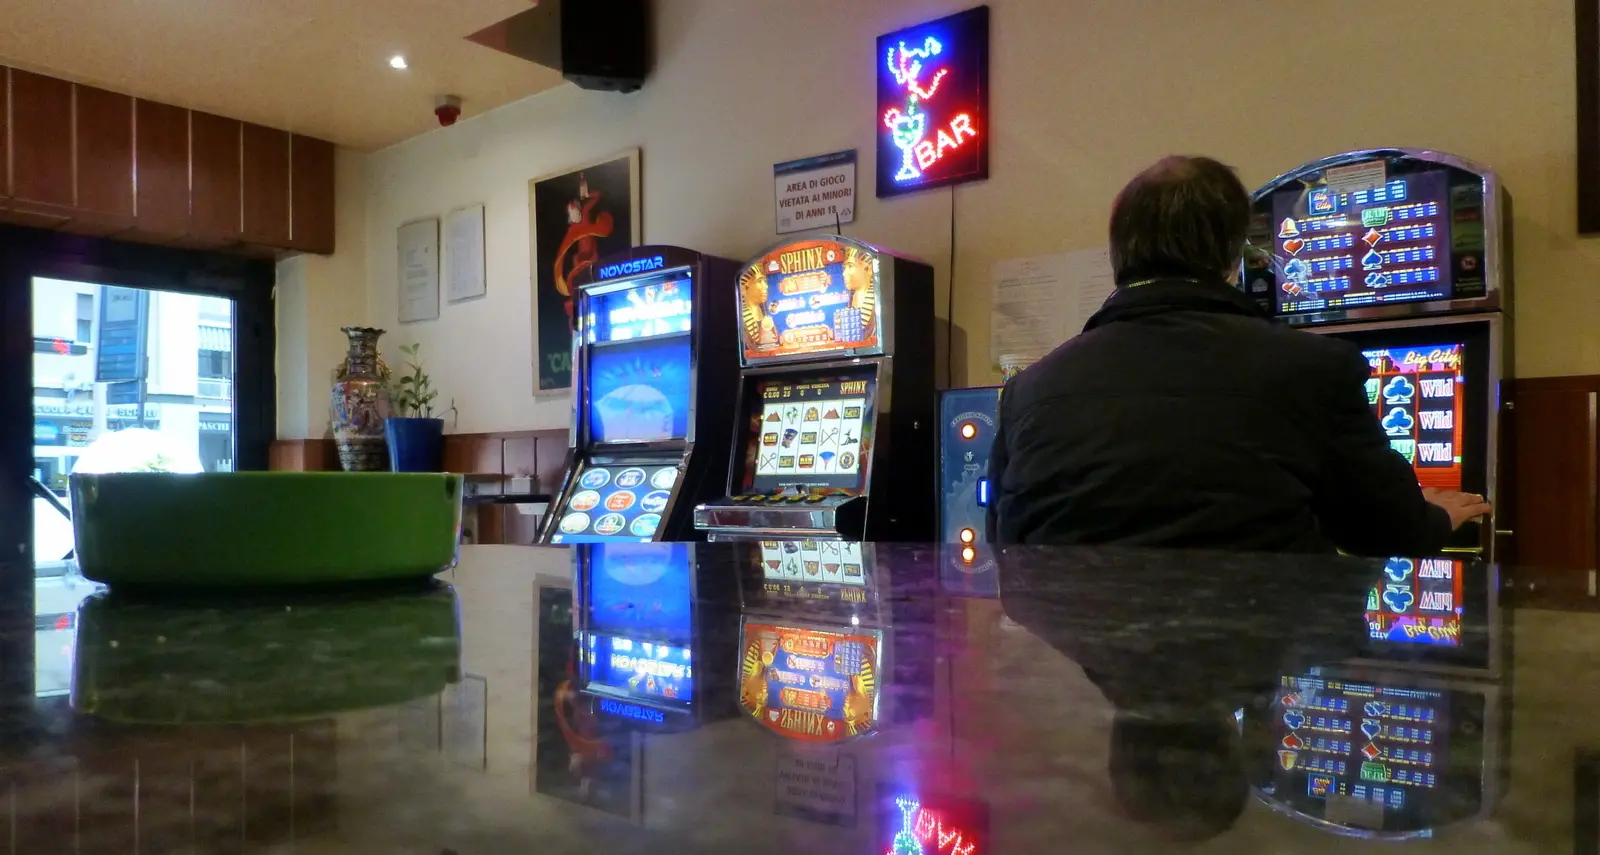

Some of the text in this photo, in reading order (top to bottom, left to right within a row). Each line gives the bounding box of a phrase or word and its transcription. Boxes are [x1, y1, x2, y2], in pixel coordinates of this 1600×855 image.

[913, 112, 976, 171] BAR
[786, 174, 846, 193] AREA DI GIOCO
[779, 188, 852, 208] VIETATA AI MINORI
[796, 205, 836, 220] DI ANNI 18
[600, 256, 664, 280] NOVOSTAR
[780, 246, 824, 274] SPHINX
[1404, 349, 1460, 368] Big City
[840, 380, 868, 395] SPHINX
[1419, 379, 1454, 397] Wild
[1418, 410, 1453, 429] Wild
[1418, 442, 1452, 462] Wild
